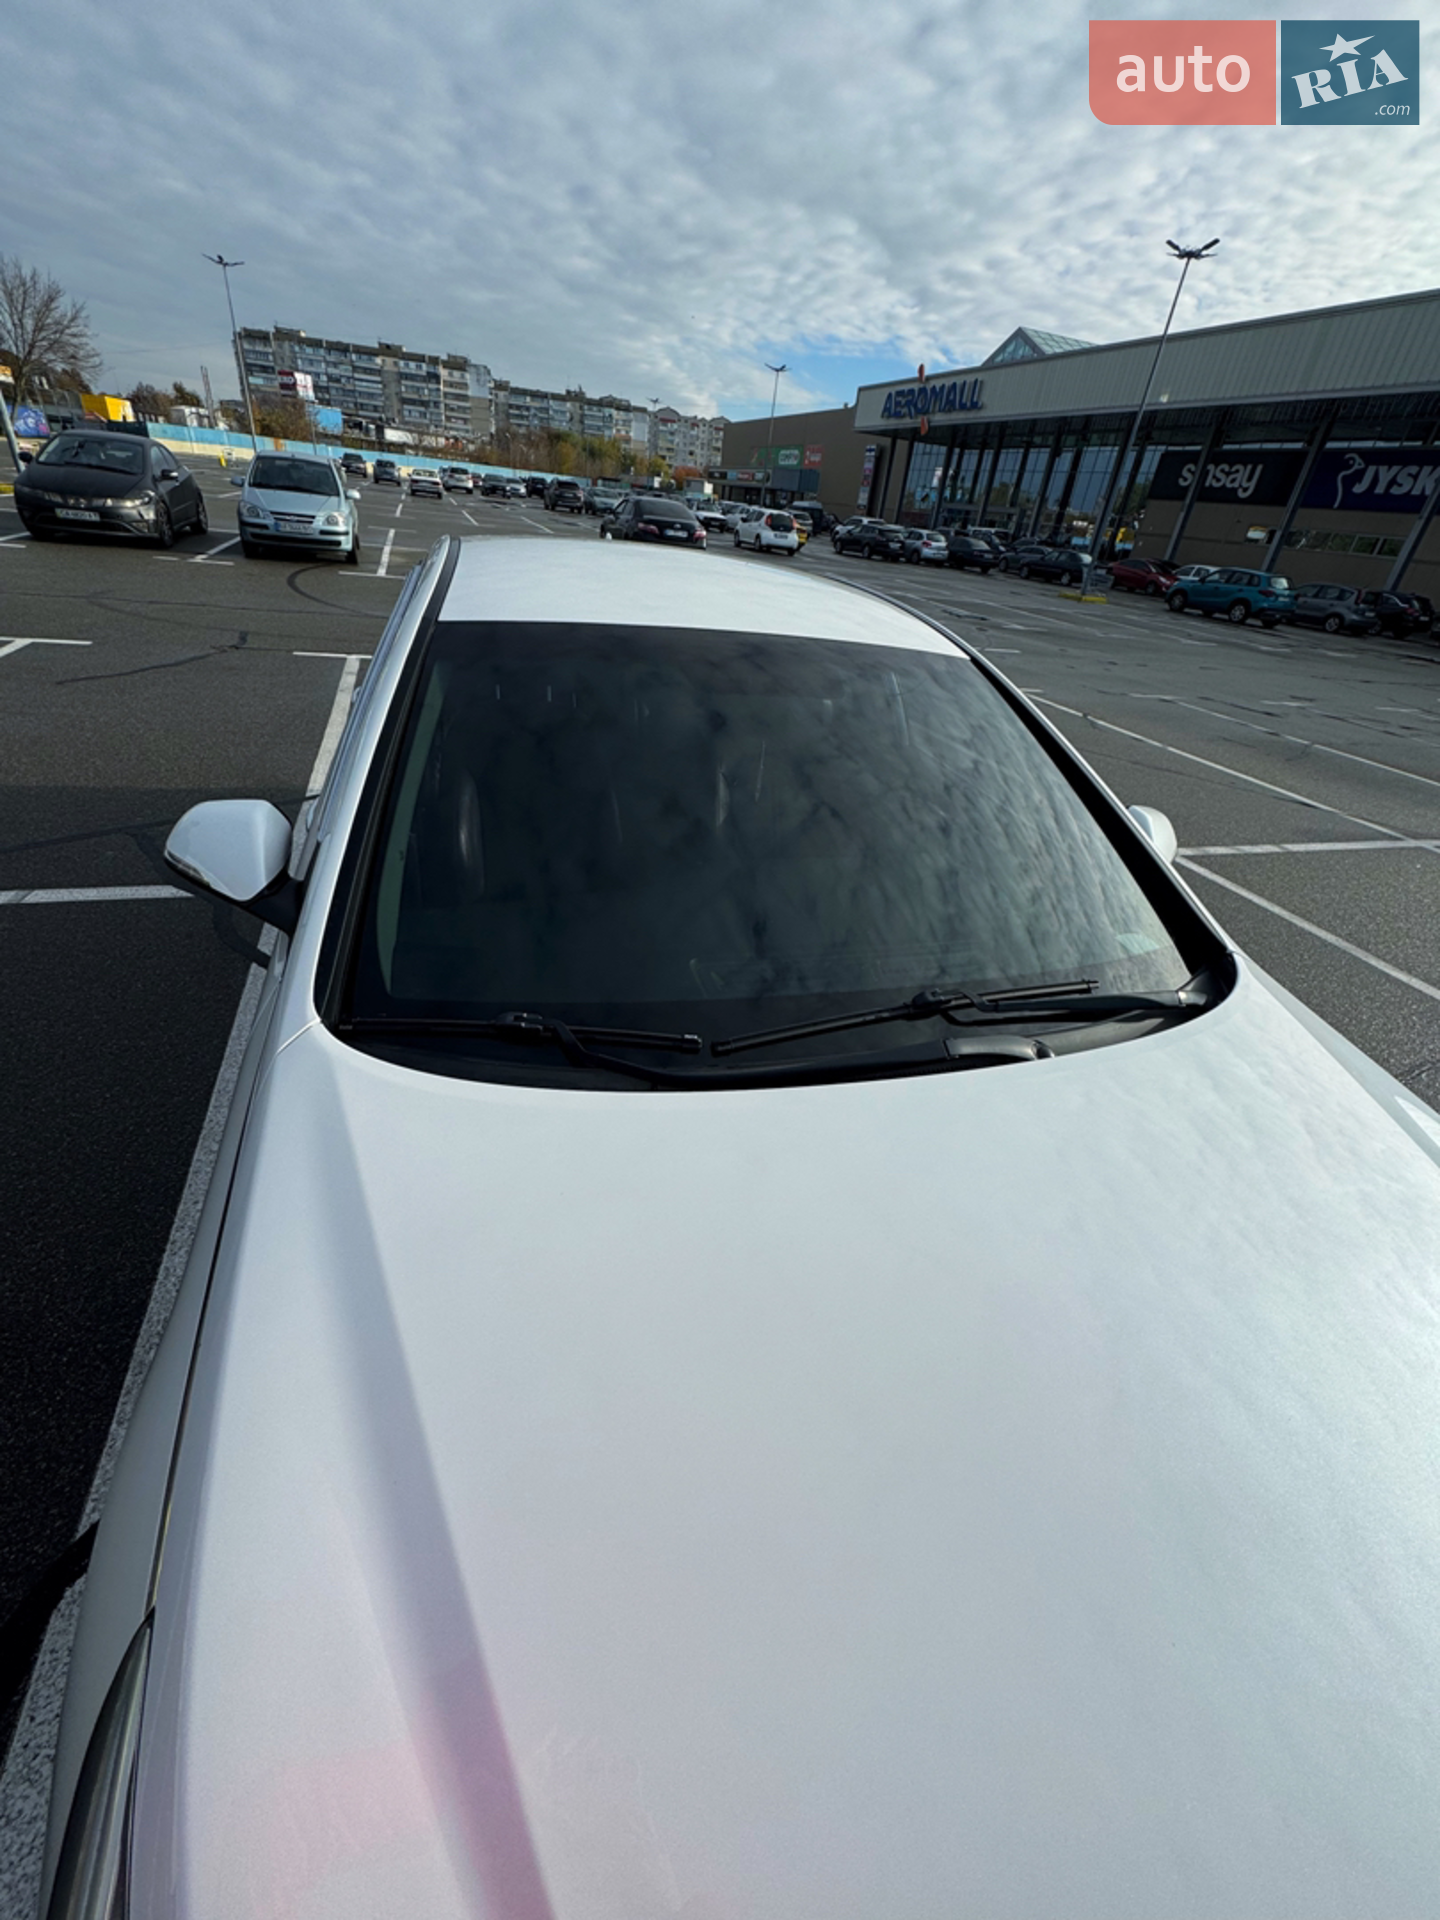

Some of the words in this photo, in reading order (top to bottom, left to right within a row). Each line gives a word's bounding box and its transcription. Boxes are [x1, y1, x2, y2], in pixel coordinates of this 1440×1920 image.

[881, 378, 983, 419] AEROMALL
[1178, 463, 1264, 499] snsay
[1351, 465, 1440, 496] JYSK
